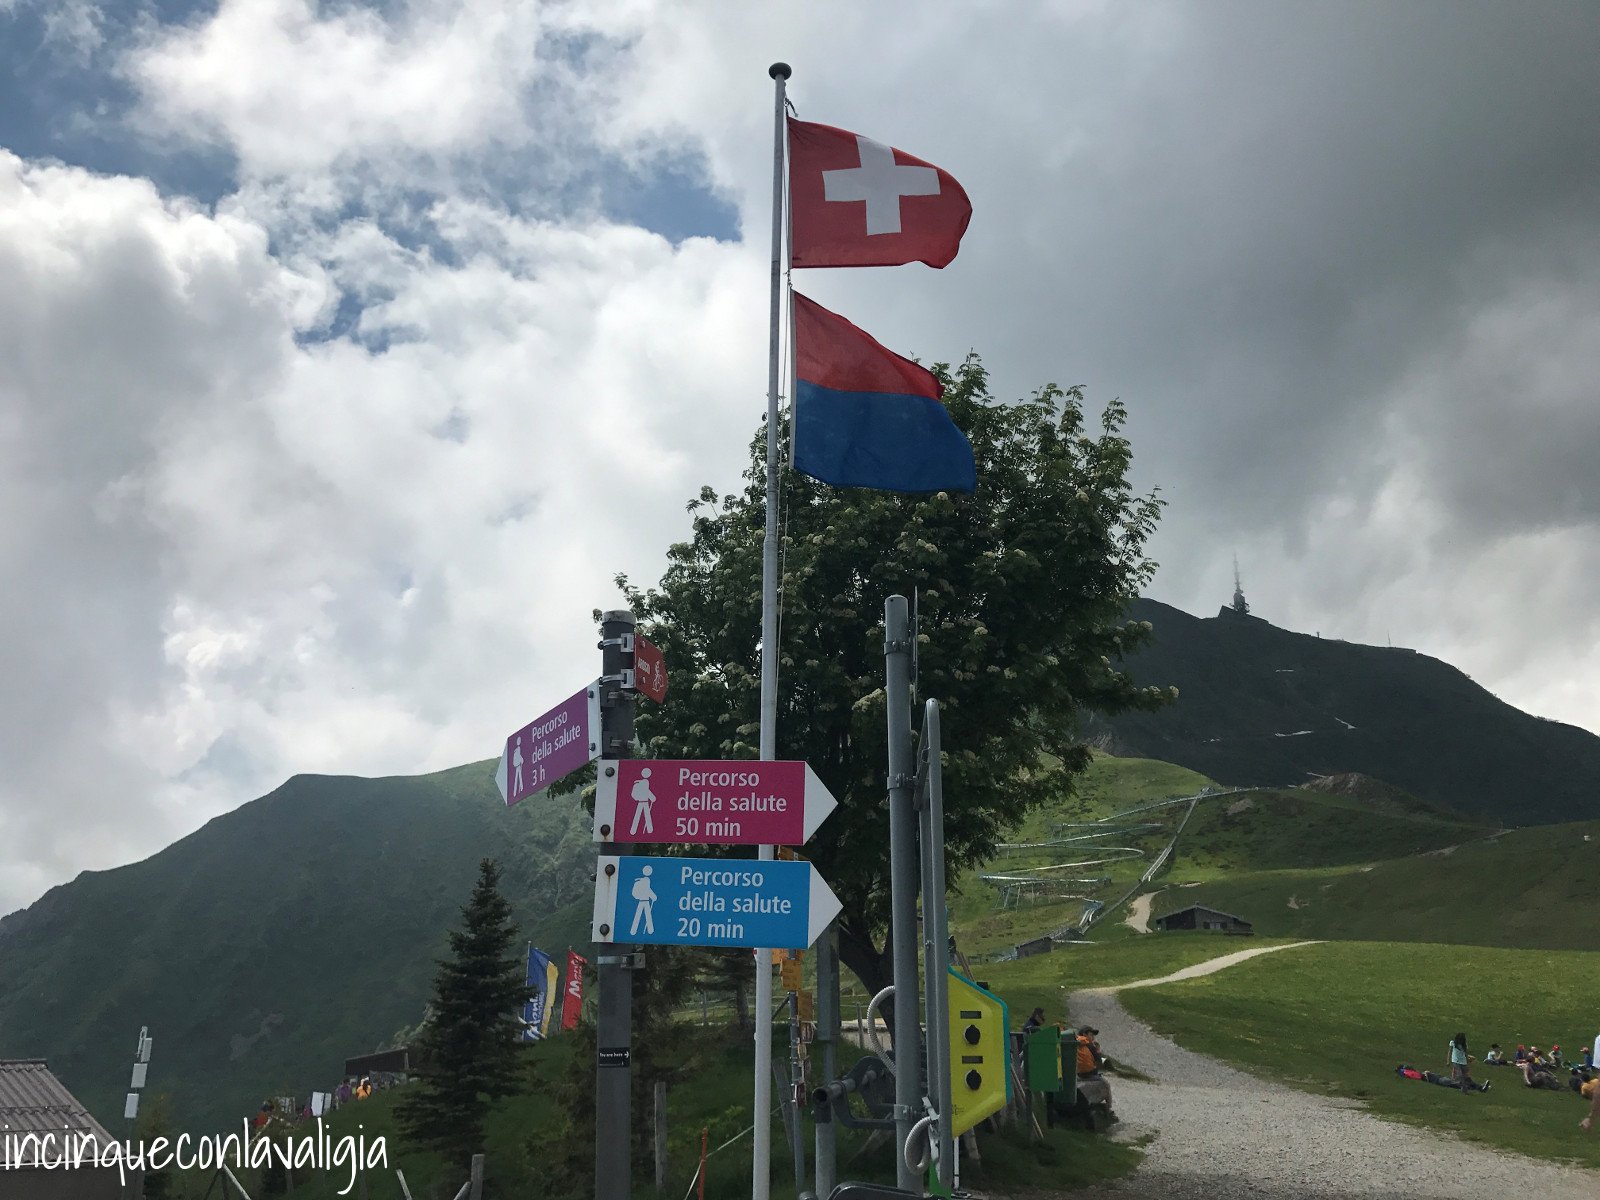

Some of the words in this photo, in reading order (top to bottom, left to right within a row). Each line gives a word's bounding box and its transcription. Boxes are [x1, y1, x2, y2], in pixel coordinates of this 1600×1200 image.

[532, 710, 568, 743] Percorso
[532, 737, 551, 762] della
[554, 724, 581, 751] salute
[532, 768, 537, 786] 3
[540, 765, 546, 782] h
[678, 767, 760, 787] Percorso
[678, 792, 723, 811] della
[729, 792, 787, 812] salute
[676, 818, 699, 837] 50
[706, 817, 741, 837] min
[680, 867, 763, 888] Percorso
[679, 891, 726, 912] della
[733, 893, 792, 914] salute
[677, 918, 701, 938] 20
[708, 919, 744, 939] min
